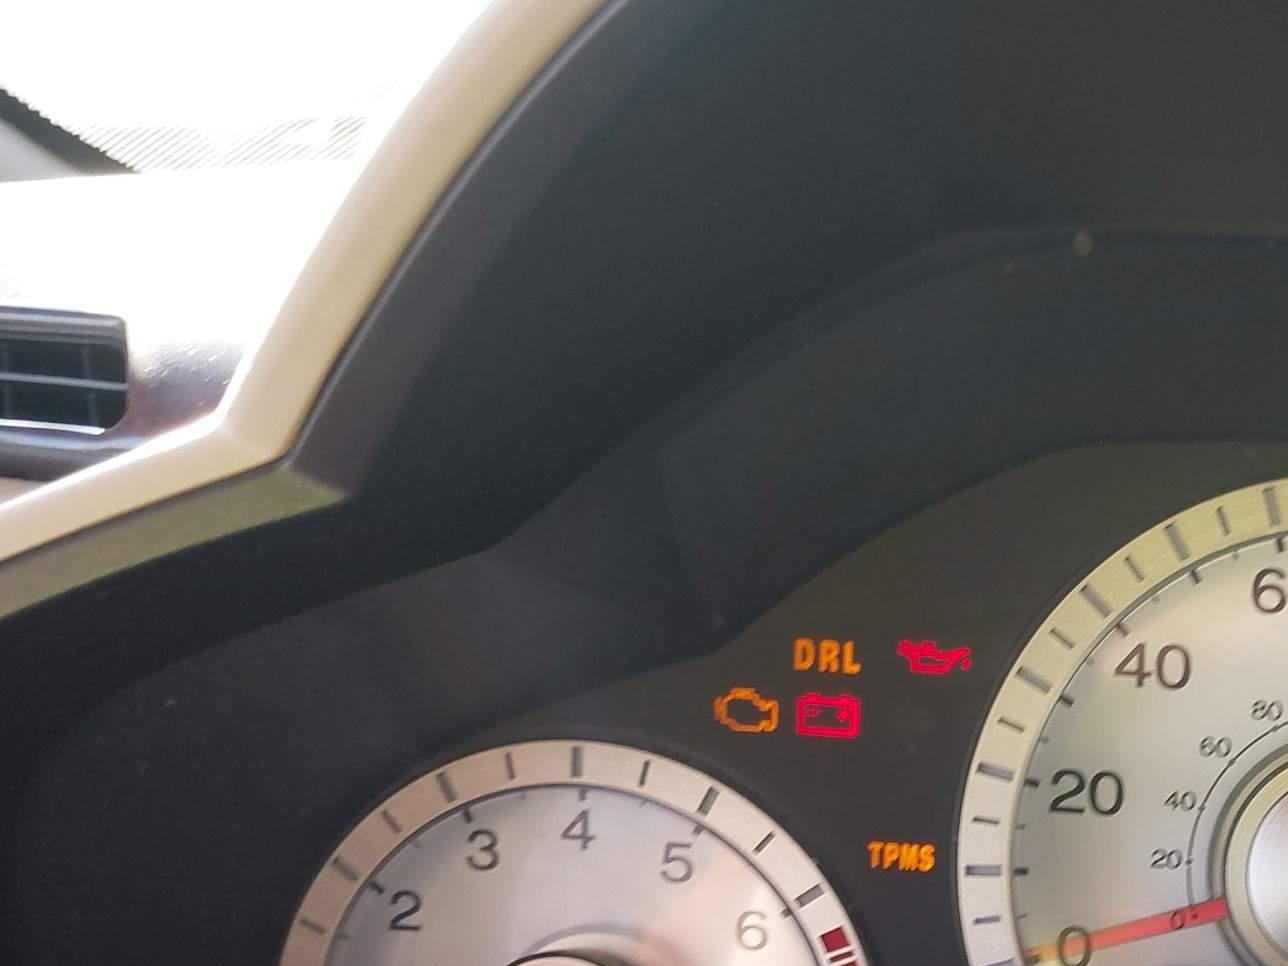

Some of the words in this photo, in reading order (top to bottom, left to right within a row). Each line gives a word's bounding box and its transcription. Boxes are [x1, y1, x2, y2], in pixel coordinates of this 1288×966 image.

[793, 637, 862, 675] DRL
[1115, 642, 1191, 690] 40
[1251, 701, 1283, 722] 80
[1200, 736, 1233, 760] 60
[1049, 769, 1124, 816] 20
[1164, 791, 1197, 812] 40
[561, 811, 595, 849] 4
[467, 831, 499, 871] 3
[661, 843, 693, 882] 5
[867, 841, 936, 872] TPMS
[1150, 850, 1182, 870] 20
[389, 891, 422, 930] 2
[1171, 911, 1185, 930] 0
[736, 912, 768, 950] 6
